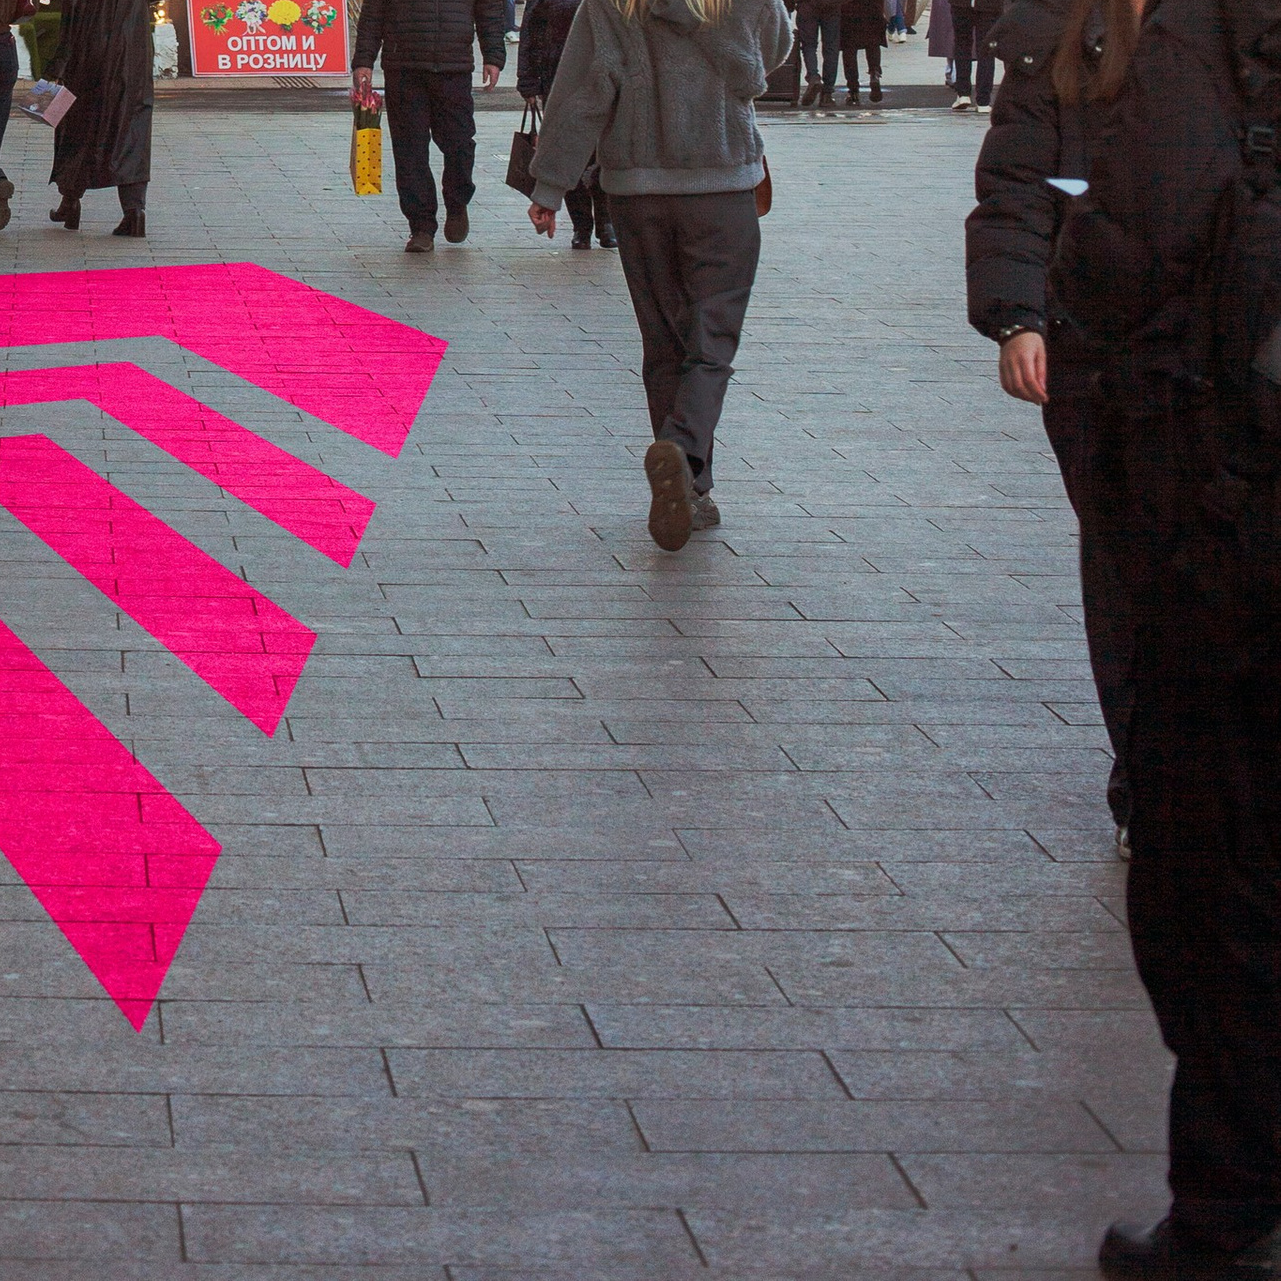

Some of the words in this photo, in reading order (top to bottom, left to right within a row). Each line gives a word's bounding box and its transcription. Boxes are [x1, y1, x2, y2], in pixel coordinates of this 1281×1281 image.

[227, 35, 296, 51] ОПТОМ
[302, 35, 315, 50] И
[217, 54, 231, 69] В
[237, 53, 327, 71] РОЗНИЦУ
